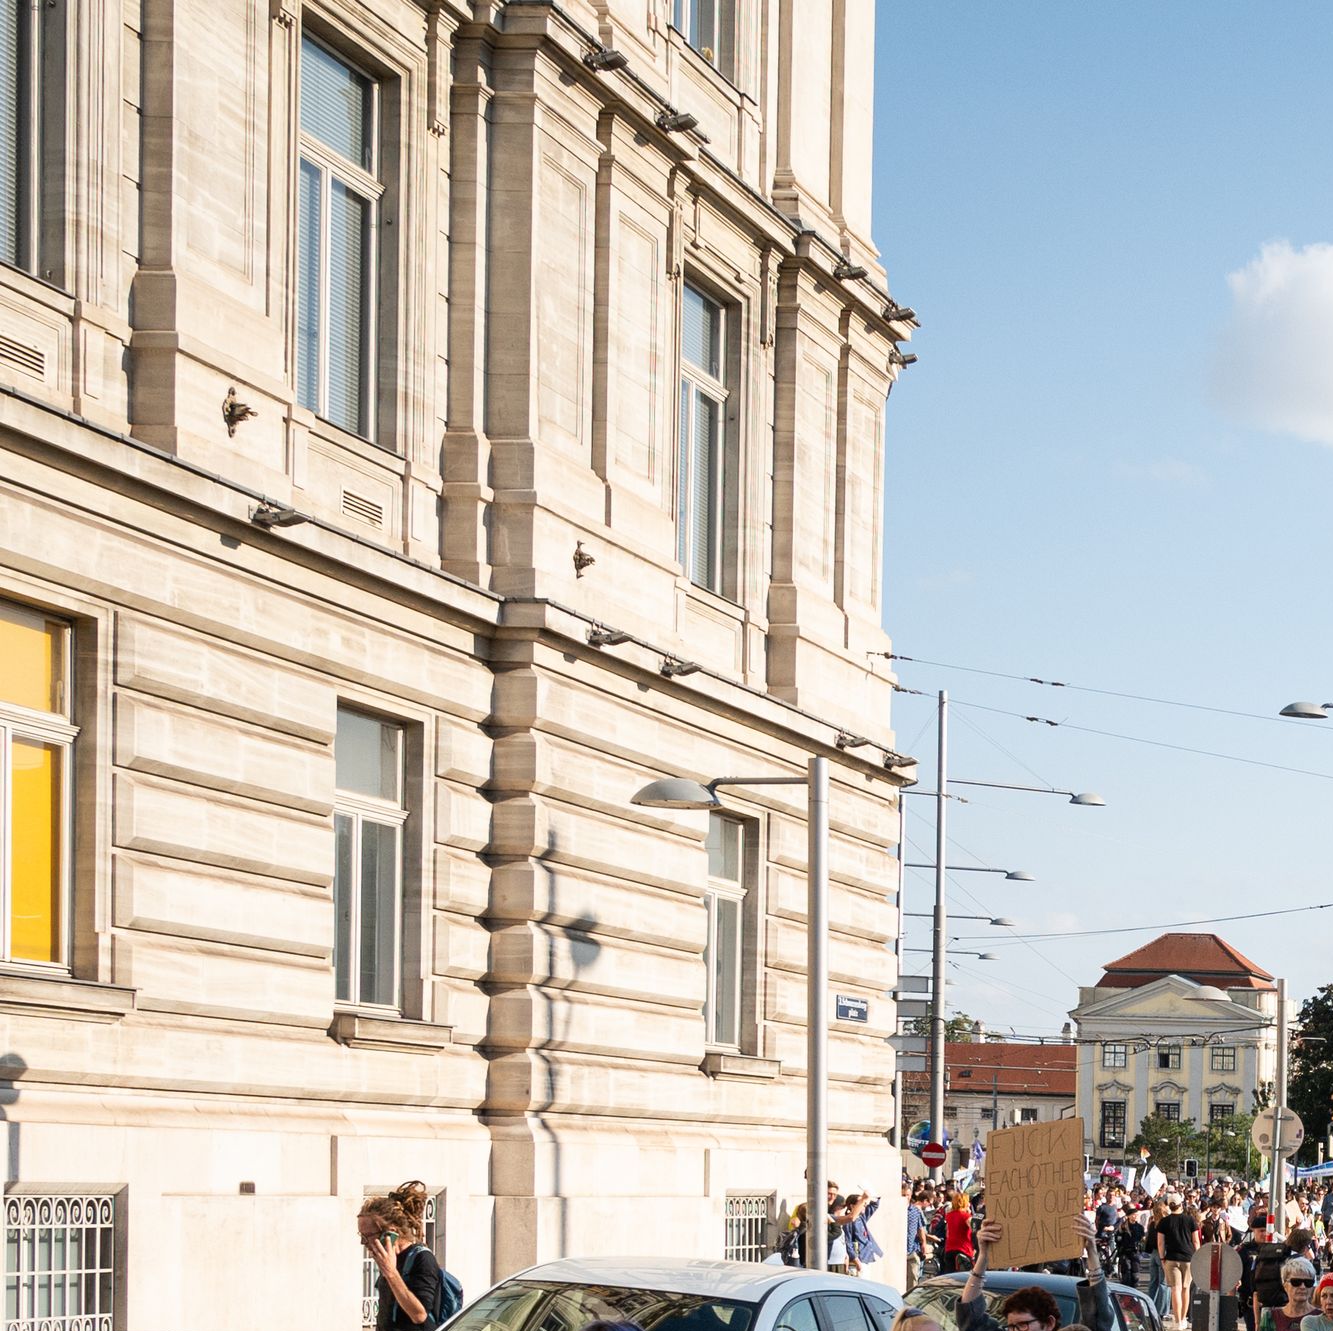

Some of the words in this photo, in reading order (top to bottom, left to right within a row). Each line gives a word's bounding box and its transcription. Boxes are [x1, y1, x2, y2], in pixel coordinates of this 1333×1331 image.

[990, 1127, 1068, 1166] FUCK
[988, 1158, 1082, 1196] EACHOTHER
[993, 1192, 1035, 1219] NOT
[1043, 1187, 1081, 1214] OUR
